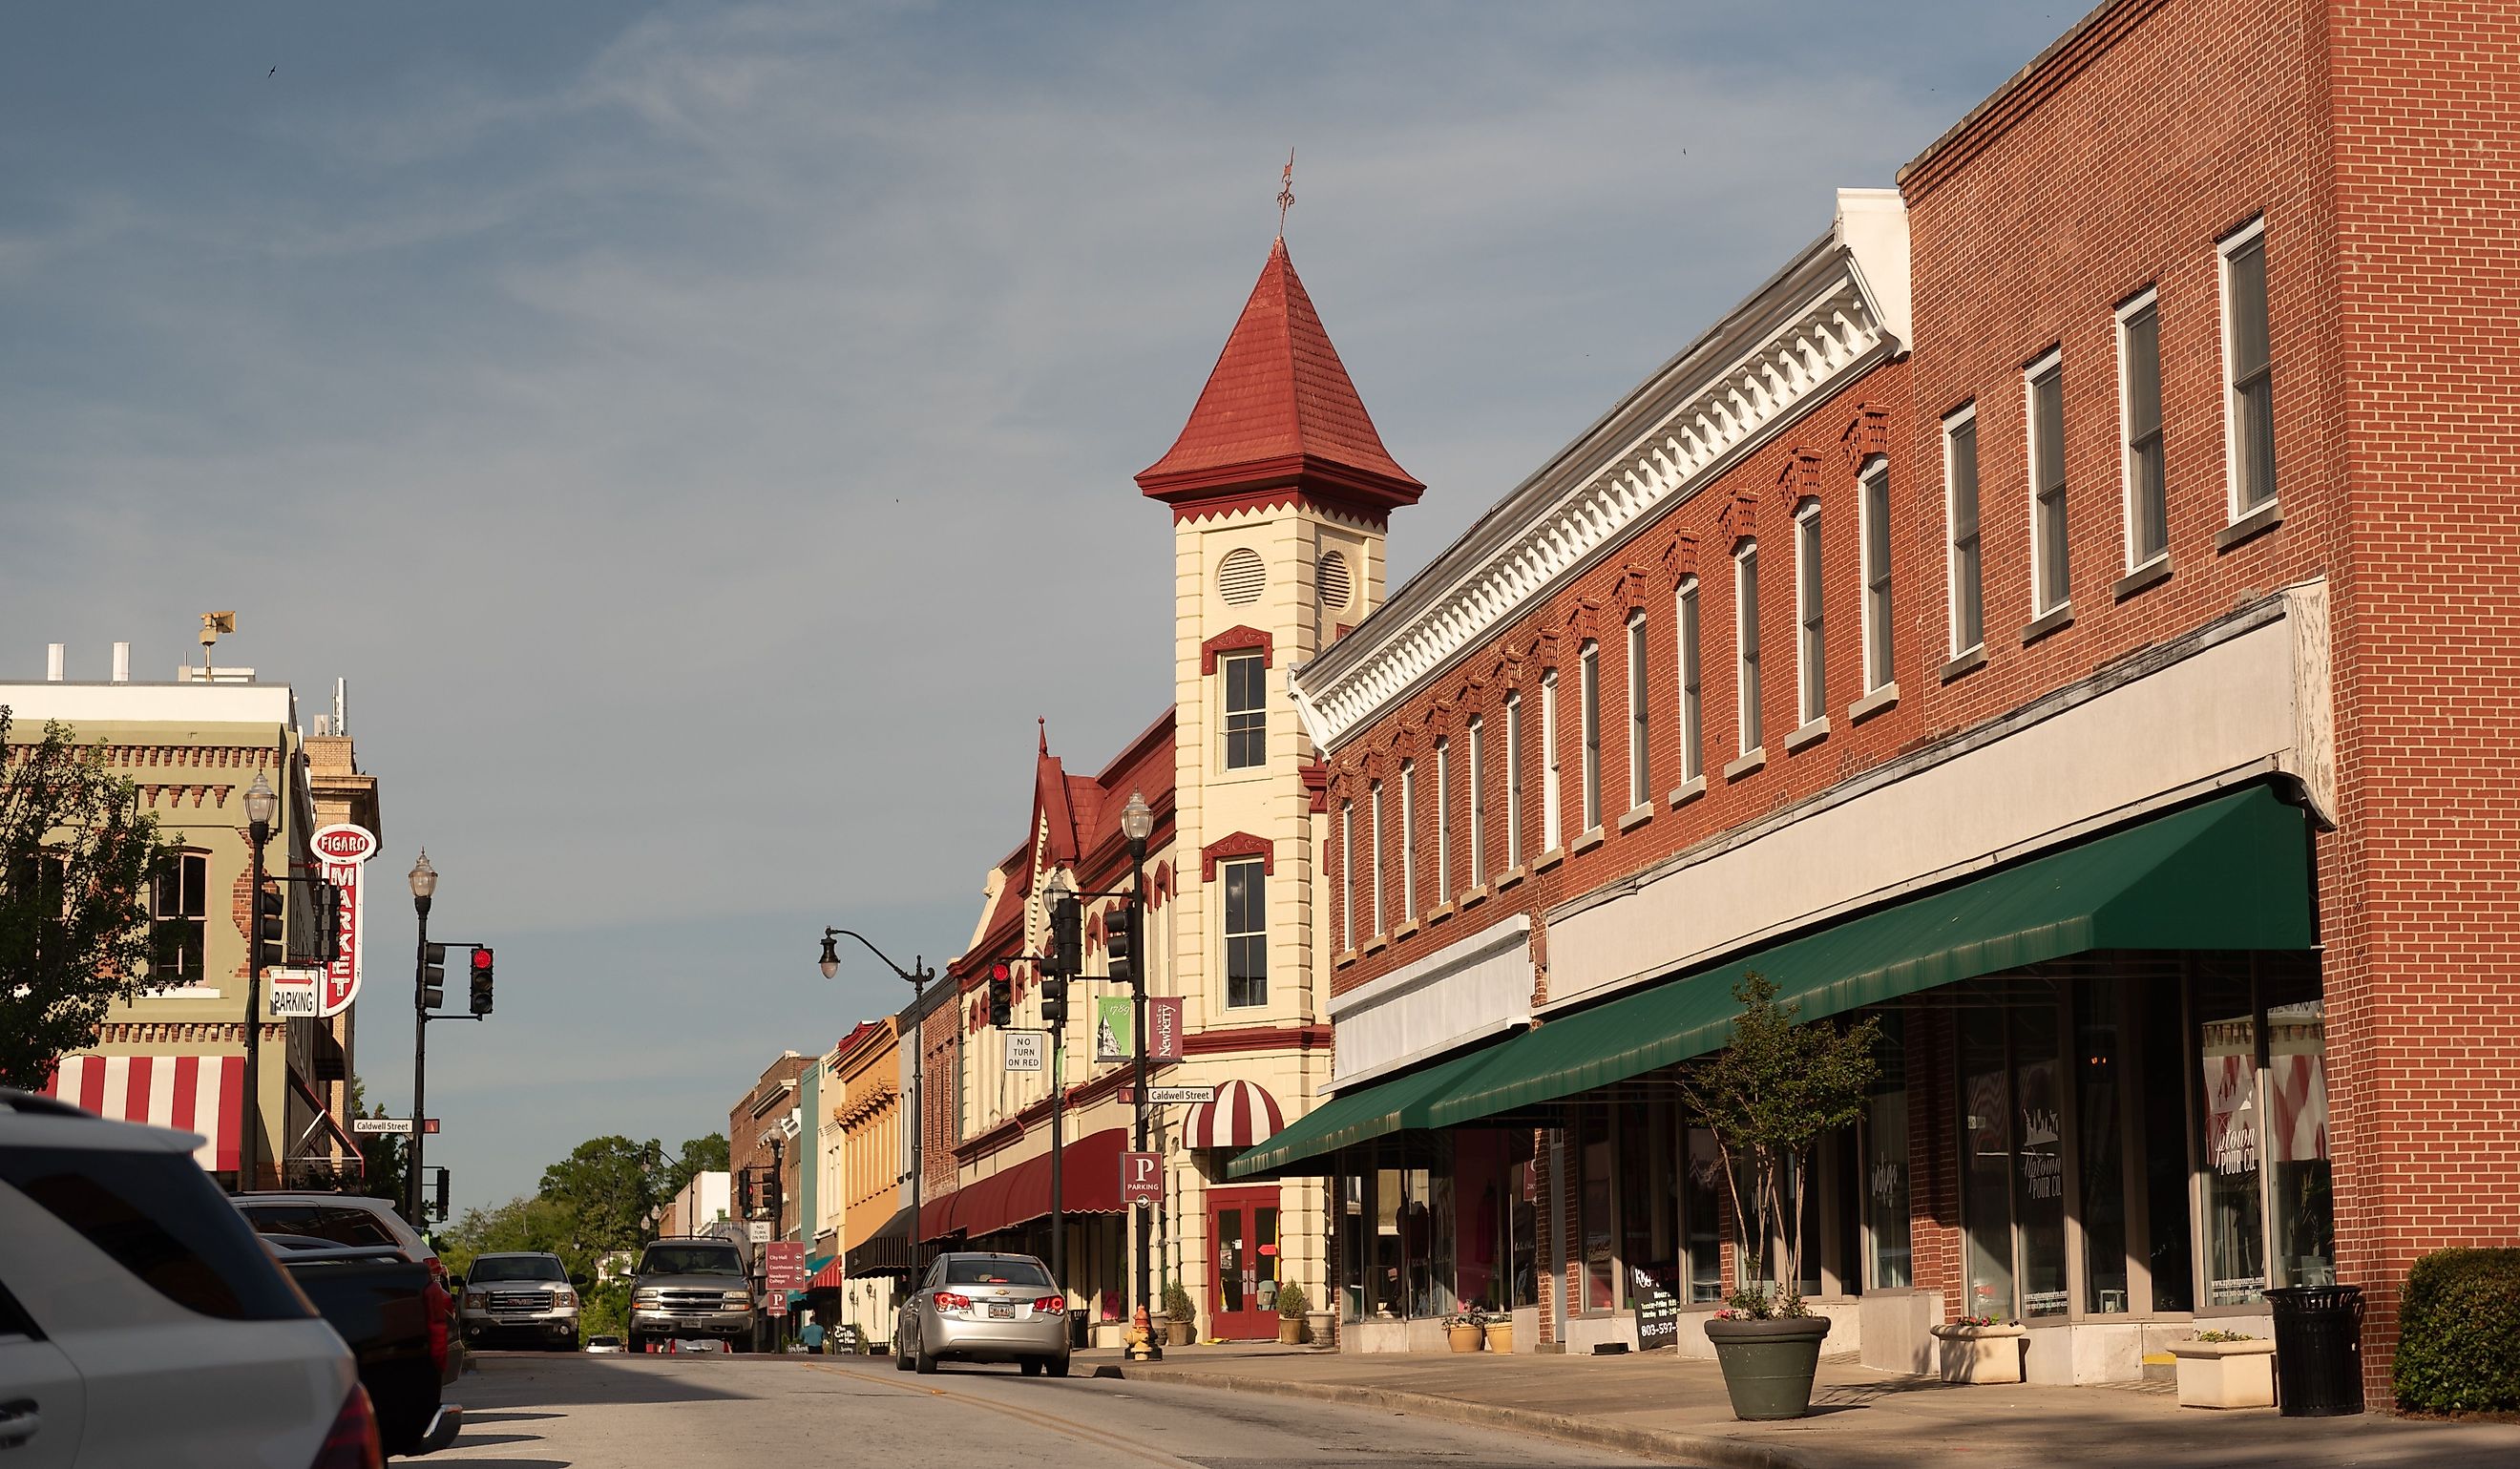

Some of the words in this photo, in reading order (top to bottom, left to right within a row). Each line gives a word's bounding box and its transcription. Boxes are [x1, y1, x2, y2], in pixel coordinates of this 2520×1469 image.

[321, 836, 367, 851] FIGARO
[274, 991, 313, 1012] PARKING
[1109, 1003, 1130, 1016] 1789
[1159, 1004, 1176, 1058] Newberry
[1151, 1090, 1185, 1100] Caldwell
[1186, 1090, 1209, 1100] Street
[357, 1122, 386, 1130] Caldwell
[1135, 1158, 1154, 1182] P
[2220, 1149, 2242, 1175] POUR
[2032, 1176, 2050, 1199] POUR
[773, 1293, 783, 1306] P
